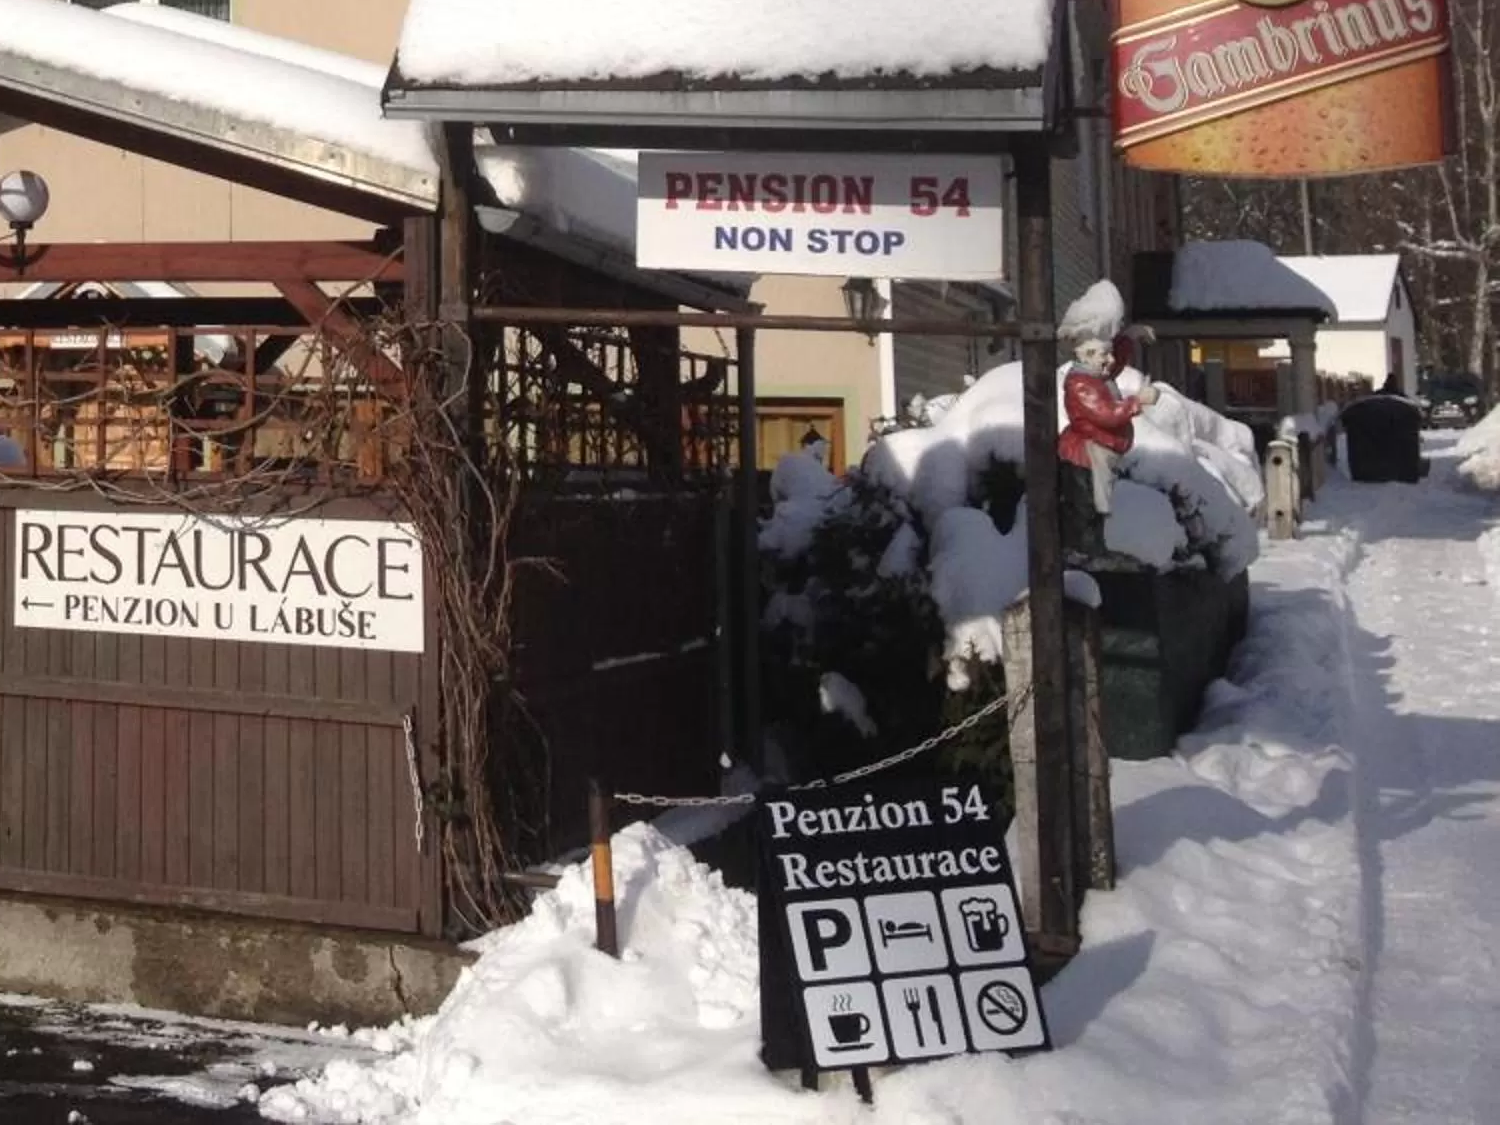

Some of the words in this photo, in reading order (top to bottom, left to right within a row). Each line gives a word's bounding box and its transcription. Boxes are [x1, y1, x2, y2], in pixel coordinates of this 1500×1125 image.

[665, 172, 875, 215] PENSION
[910, 176, 971, 217] 54
[714, 226, 793, 252] NON
[807, 229, 905, 256] STOP
[20, 522, 414, 602] RESTAURACE
[64, 594, 199, 629] PENZION
[214, 602, 234, 630] U
[249, 597, 377, 640] LÁBUŠE
[765, 792, 933, 838] Penzion
[941, 783, 990, 824] 54
[777, 845, 1002, 892] Restaurace
[801, 907, 853, 972] P
